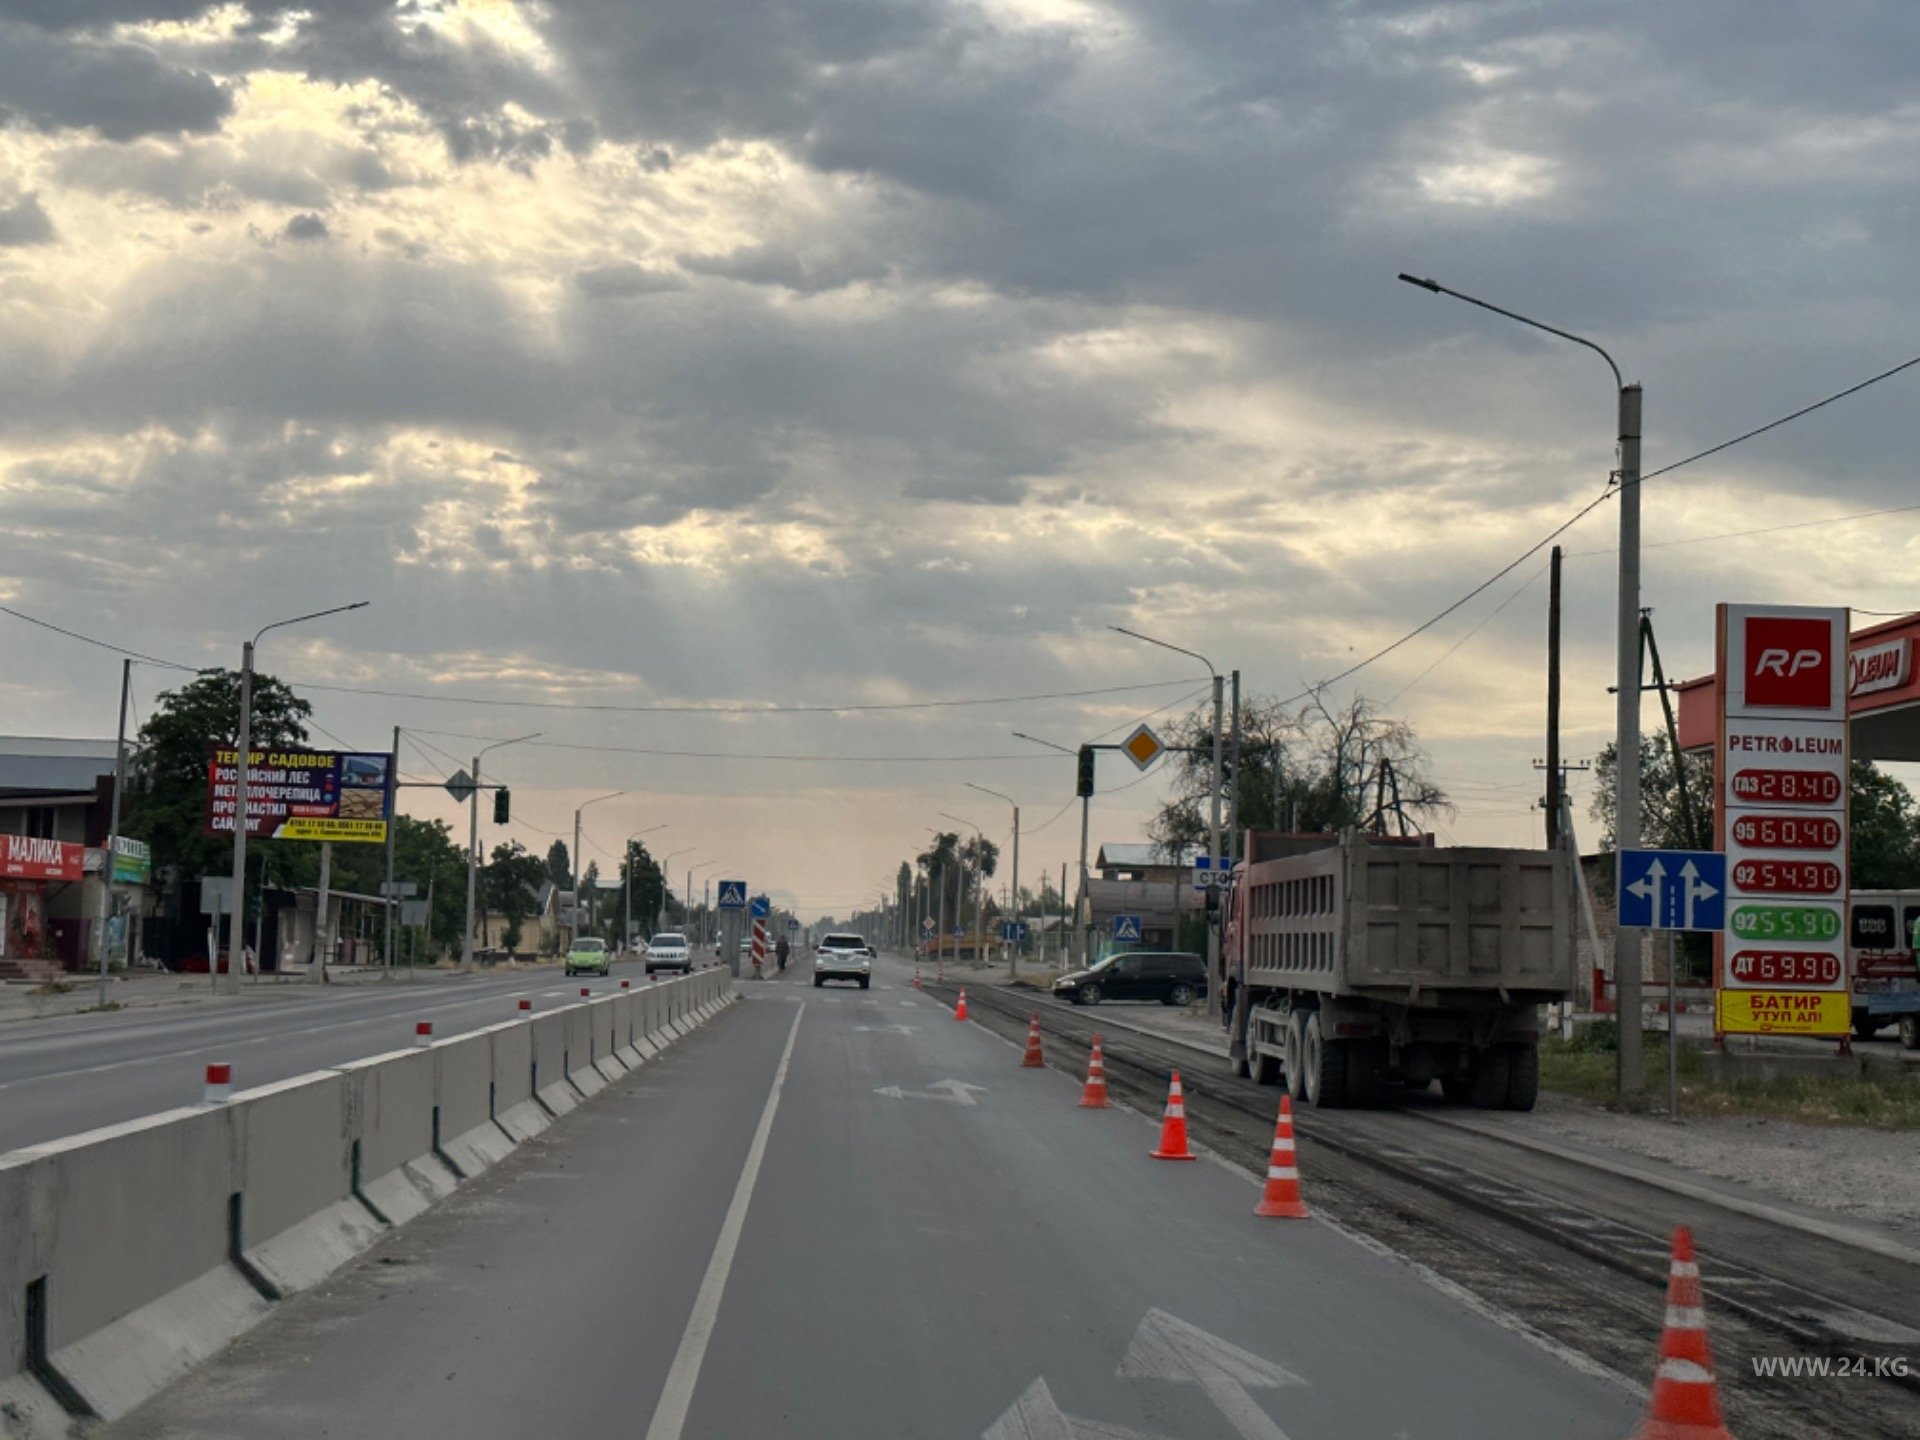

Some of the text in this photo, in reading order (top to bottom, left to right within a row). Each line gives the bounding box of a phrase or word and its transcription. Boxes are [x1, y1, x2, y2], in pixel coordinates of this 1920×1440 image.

[1754, 648, 1822, 677] RP
[1729, 735, 1842, 755] PETROLEUM
[268, 753, 335, 768] САДОВОЕ
[215, 768, 311, 784] РОСЙСКИЙ ЛЕС
[1735, 776, 1759, 793] ГАЗ
[214, 785, 321, 803] МЕТЛЛОЧЕРЕПИЦА
[212, 801, 287, 815] ПРОНАСТИЛ
[1735, 820, 1837, 845] 95 60.40
[8, 835, 63, 865] МАЛИКА
[1736, 864, 1837, 889] 92 54.90
[1735, 912, 1757, 931] 92
[1760, 911, 1836, 934] 55.90
[1735, 956, 1836, 980] ДТ 69.90
[1751, 995, 1822, 1010] БАТИР
[1752, 1011, 1822, 1023] УТУП АЛ!
